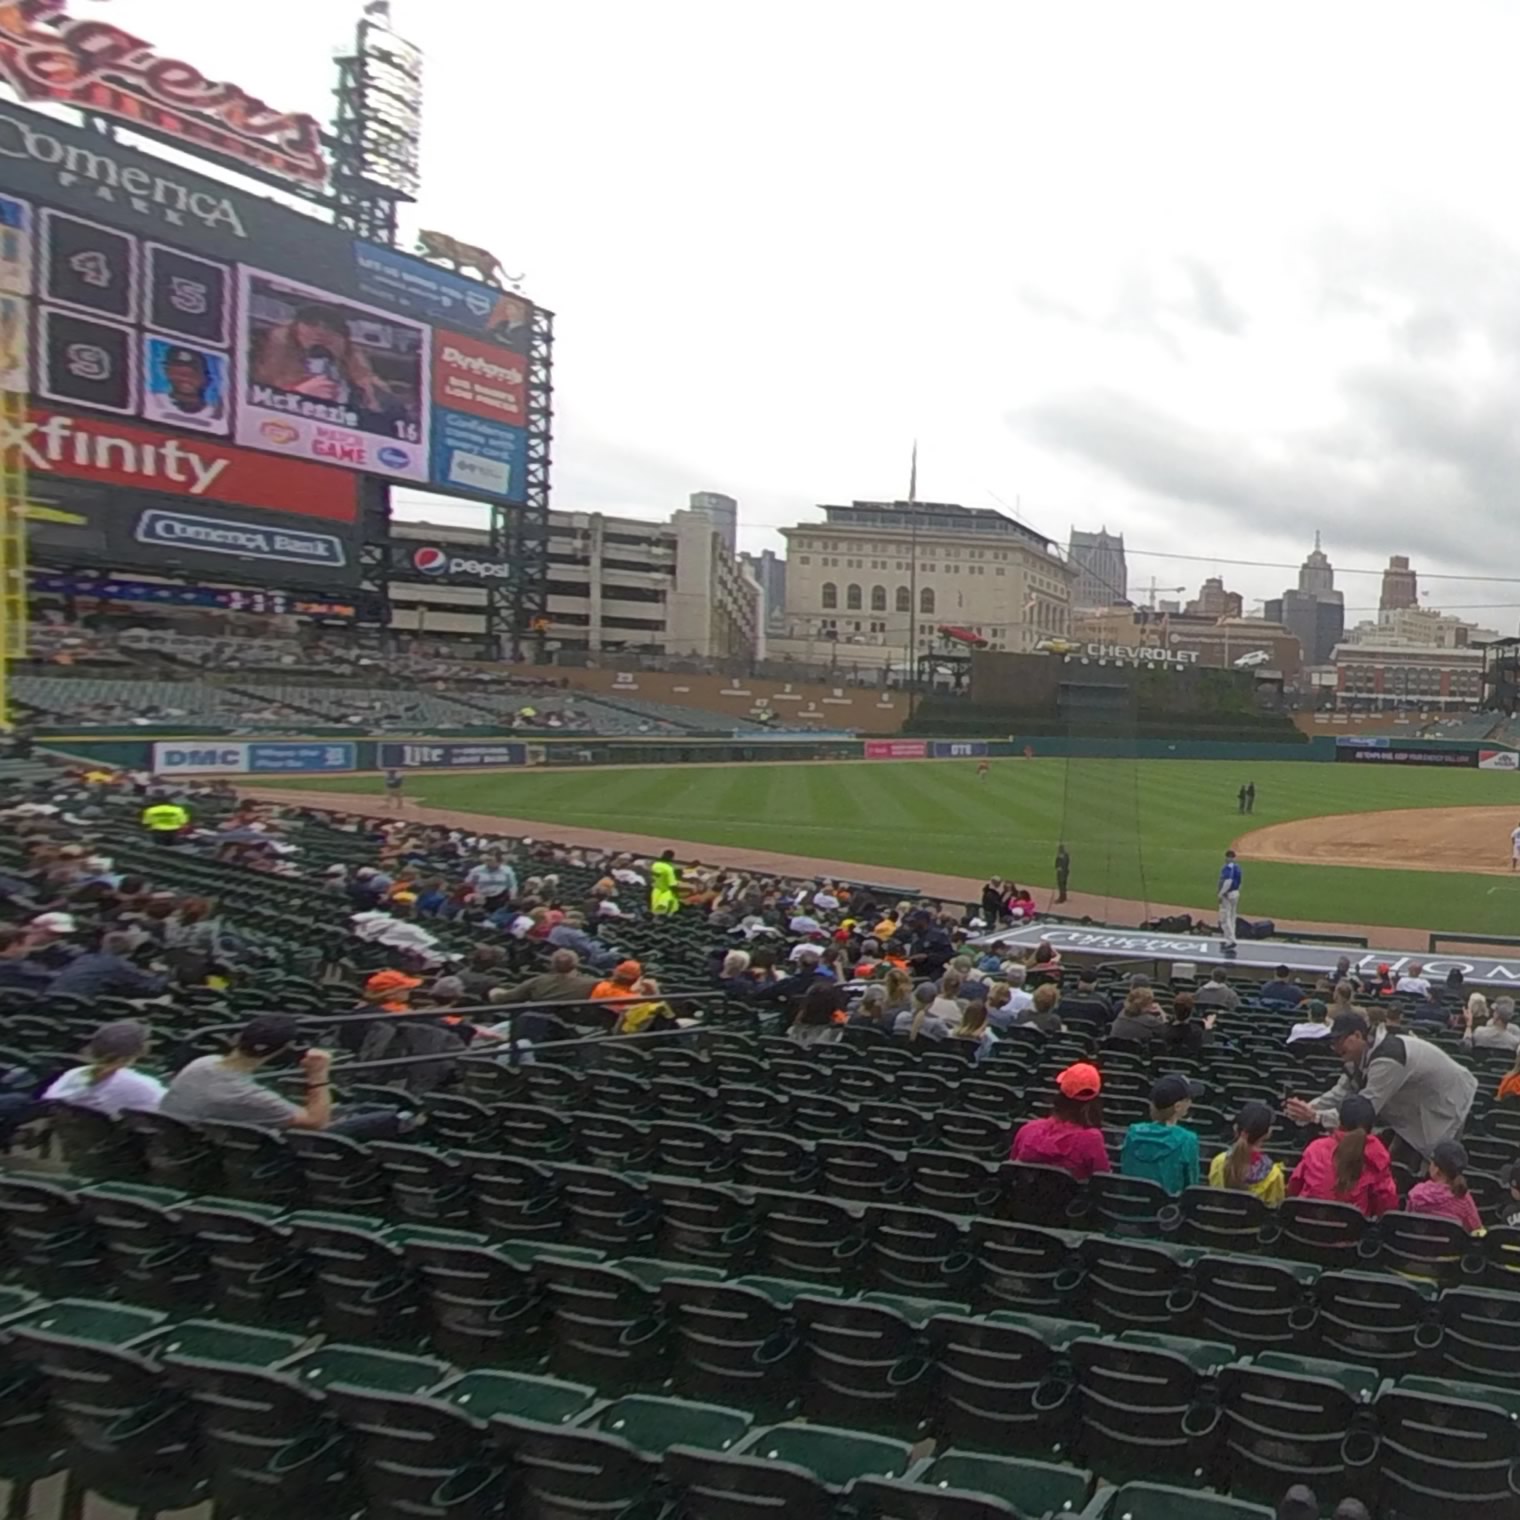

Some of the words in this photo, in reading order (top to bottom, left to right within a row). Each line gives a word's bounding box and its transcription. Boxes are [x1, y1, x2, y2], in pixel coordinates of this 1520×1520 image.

[252, 385, 358, 427] McKenzie
[394, 419, 418, 443] 16
[273, 534, 331, 557] Bank
[450, 557, 510, 579] pepsi
[1086, 642, 1200, 664] CHEVROLET
[164, 750, 240, 767] DMC
[403, 746, 445, 766] Lite
